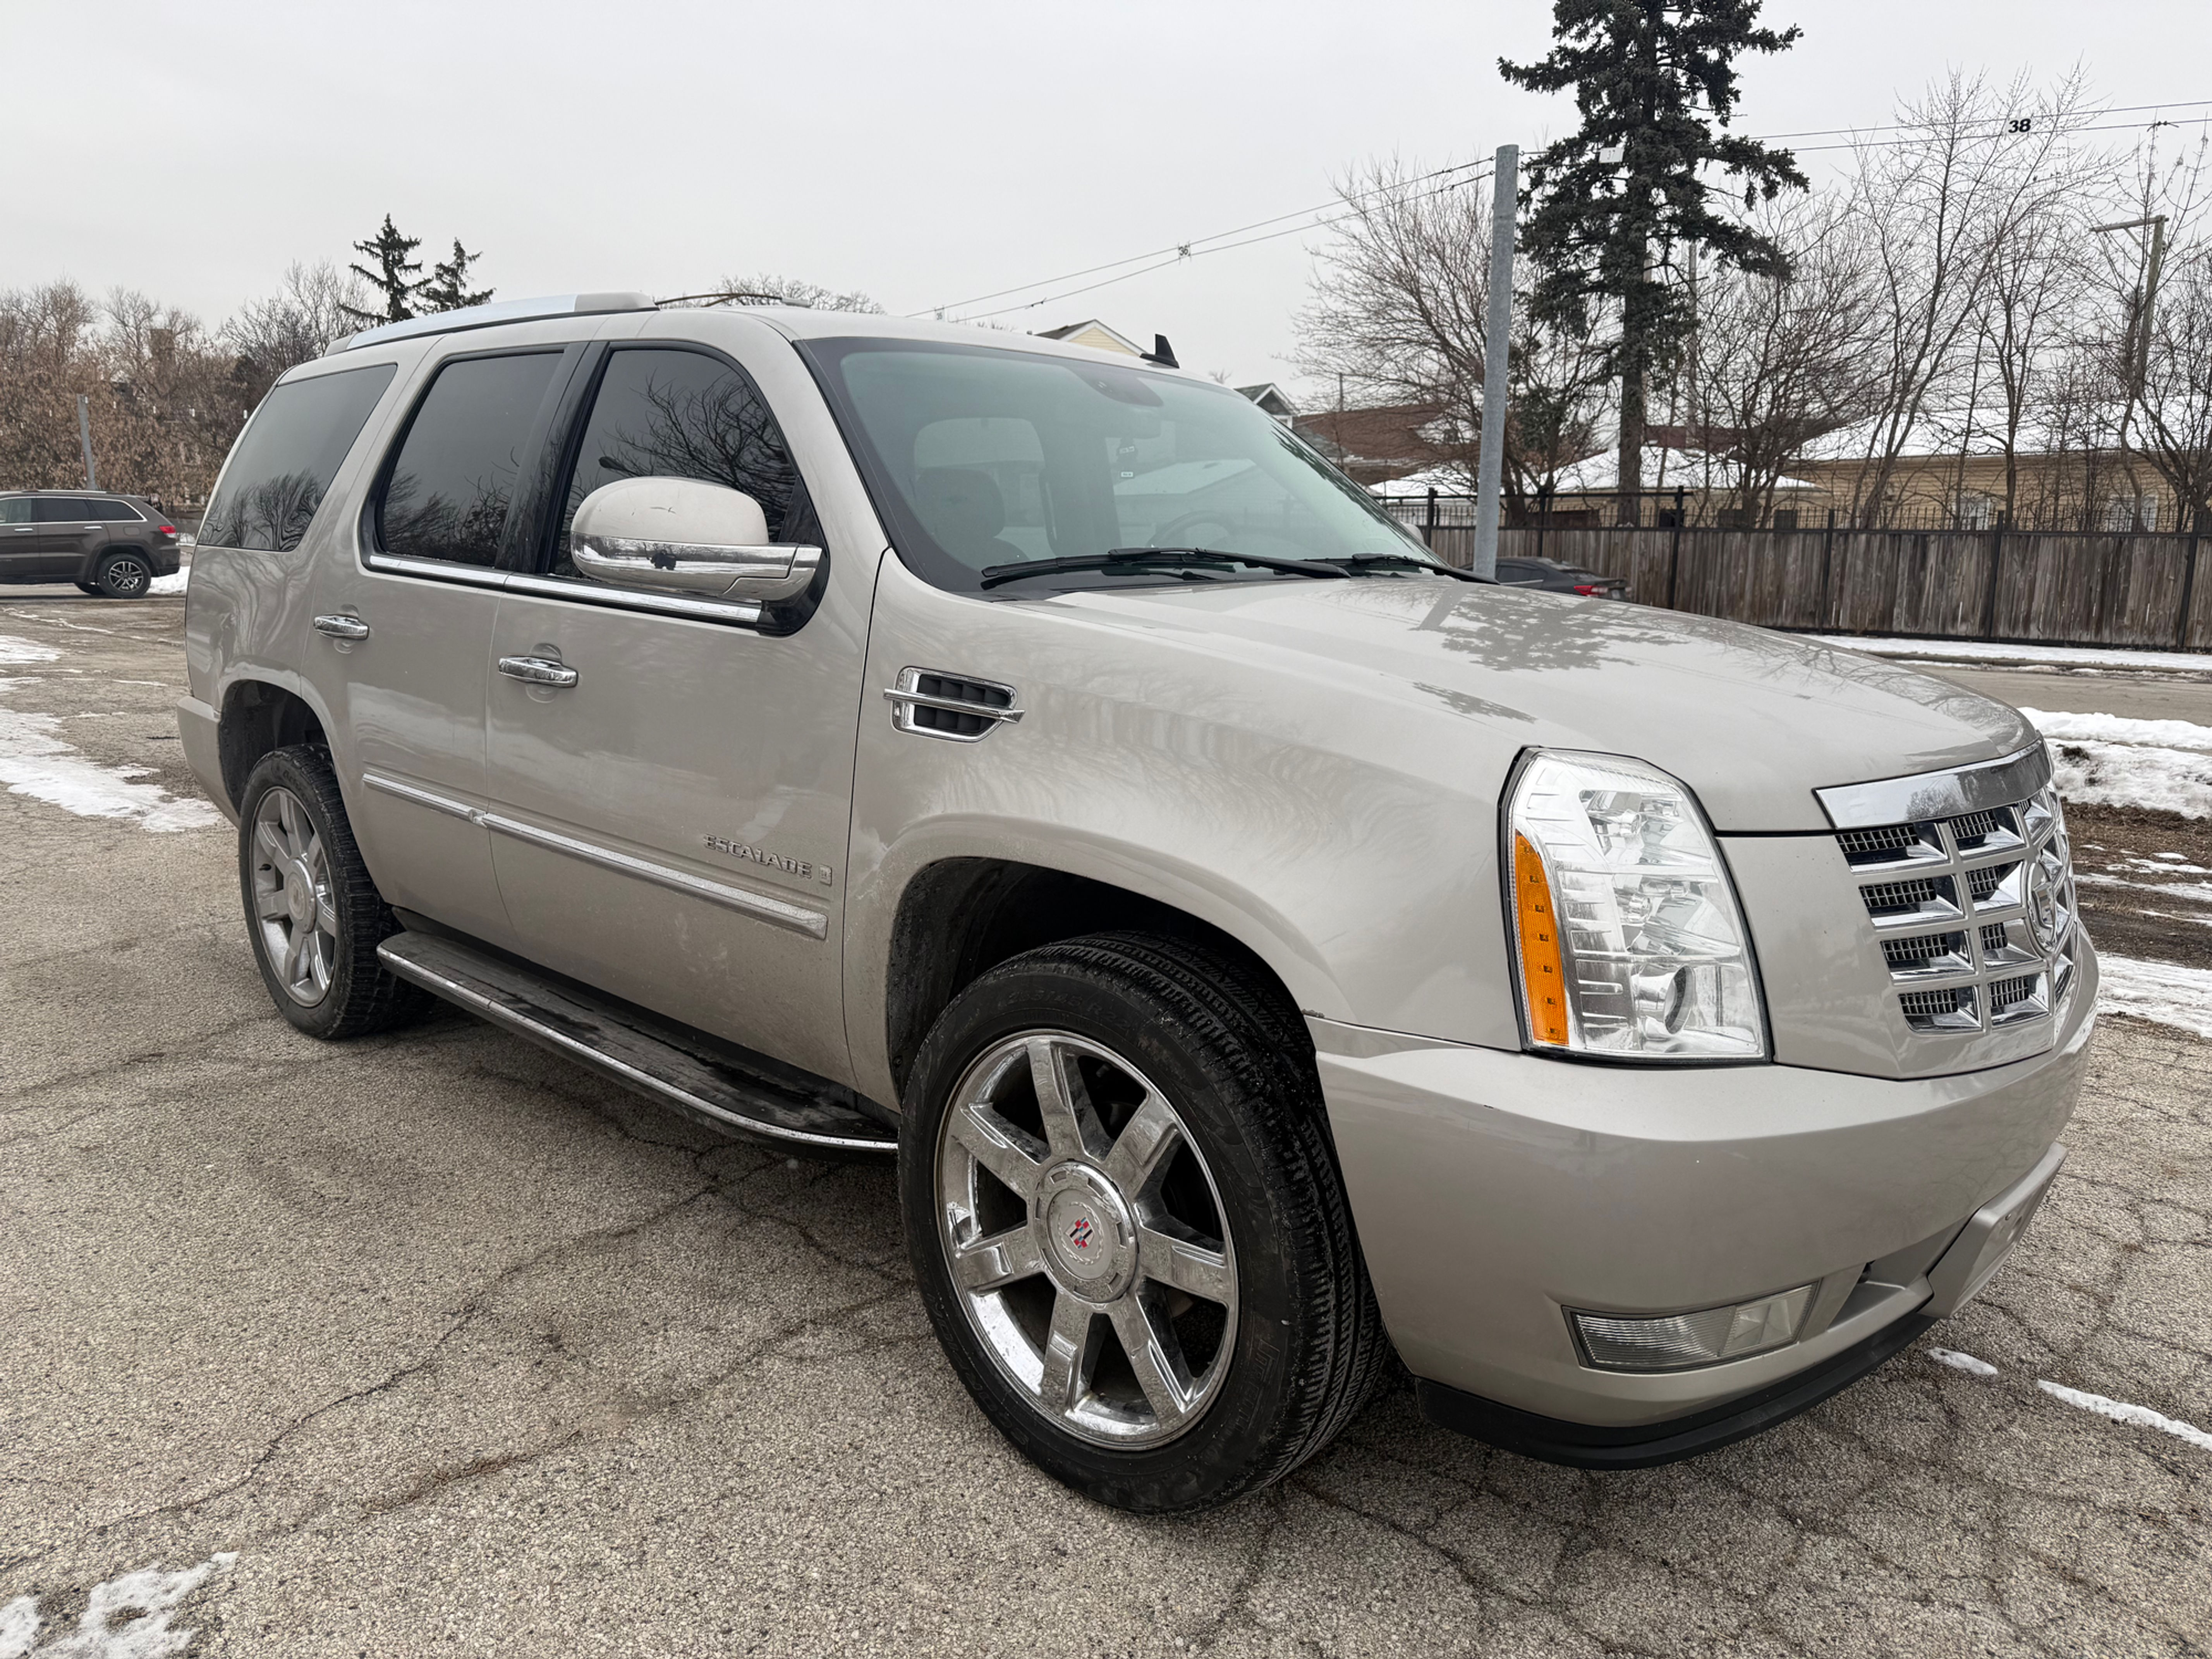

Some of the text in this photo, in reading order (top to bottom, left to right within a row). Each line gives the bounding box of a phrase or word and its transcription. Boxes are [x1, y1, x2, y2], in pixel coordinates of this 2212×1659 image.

[2008, 118, 2031, 133] 38
[1607, 149, 1615, 160] 37
[1179, 245, 1188, 256] 36
[703, 834, 812, 879] ESCALADE
